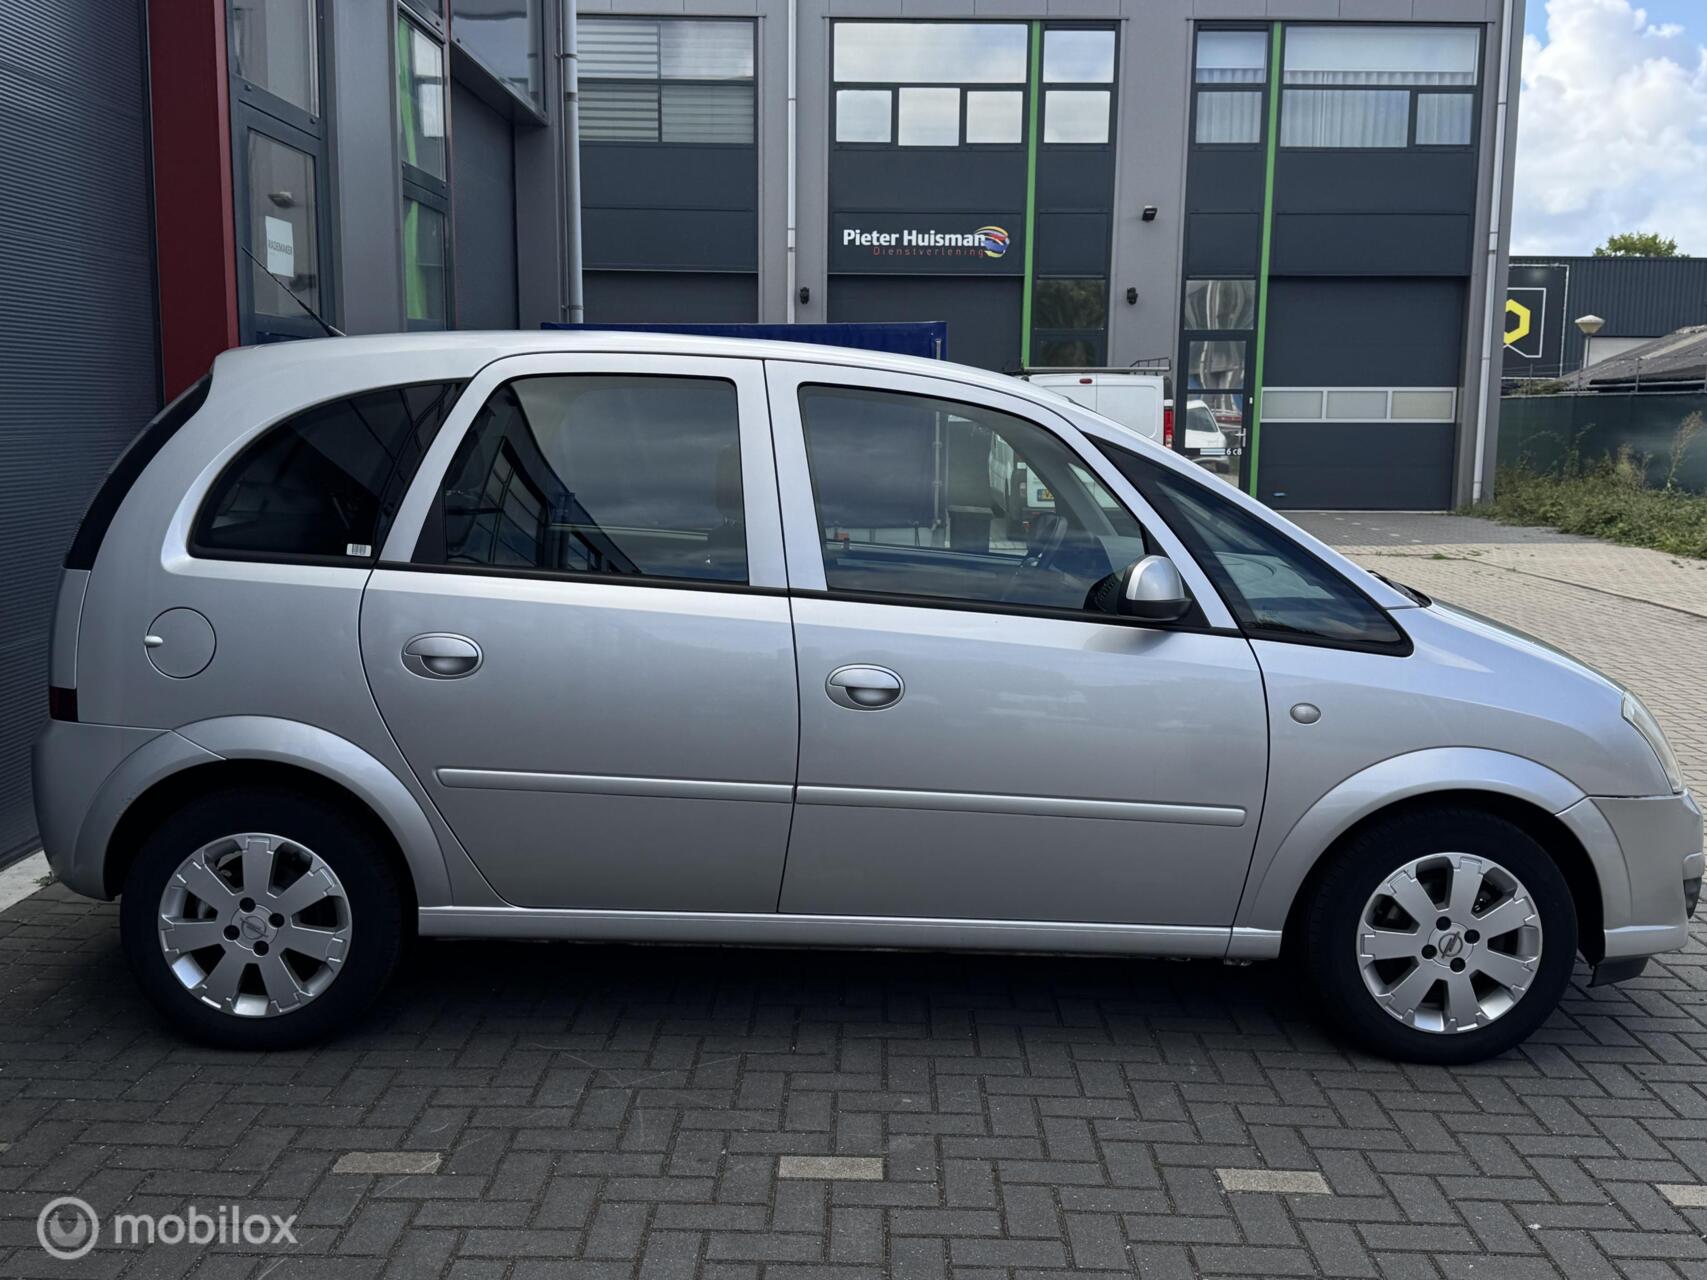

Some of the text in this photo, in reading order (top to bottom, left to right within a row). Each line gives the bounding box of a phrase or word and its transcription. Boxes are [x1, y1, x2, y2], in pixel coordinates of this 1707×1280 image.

[843, 229, 985, 246] Pieter Huisman
[873, 247, 984, 258] Dienstverlening
